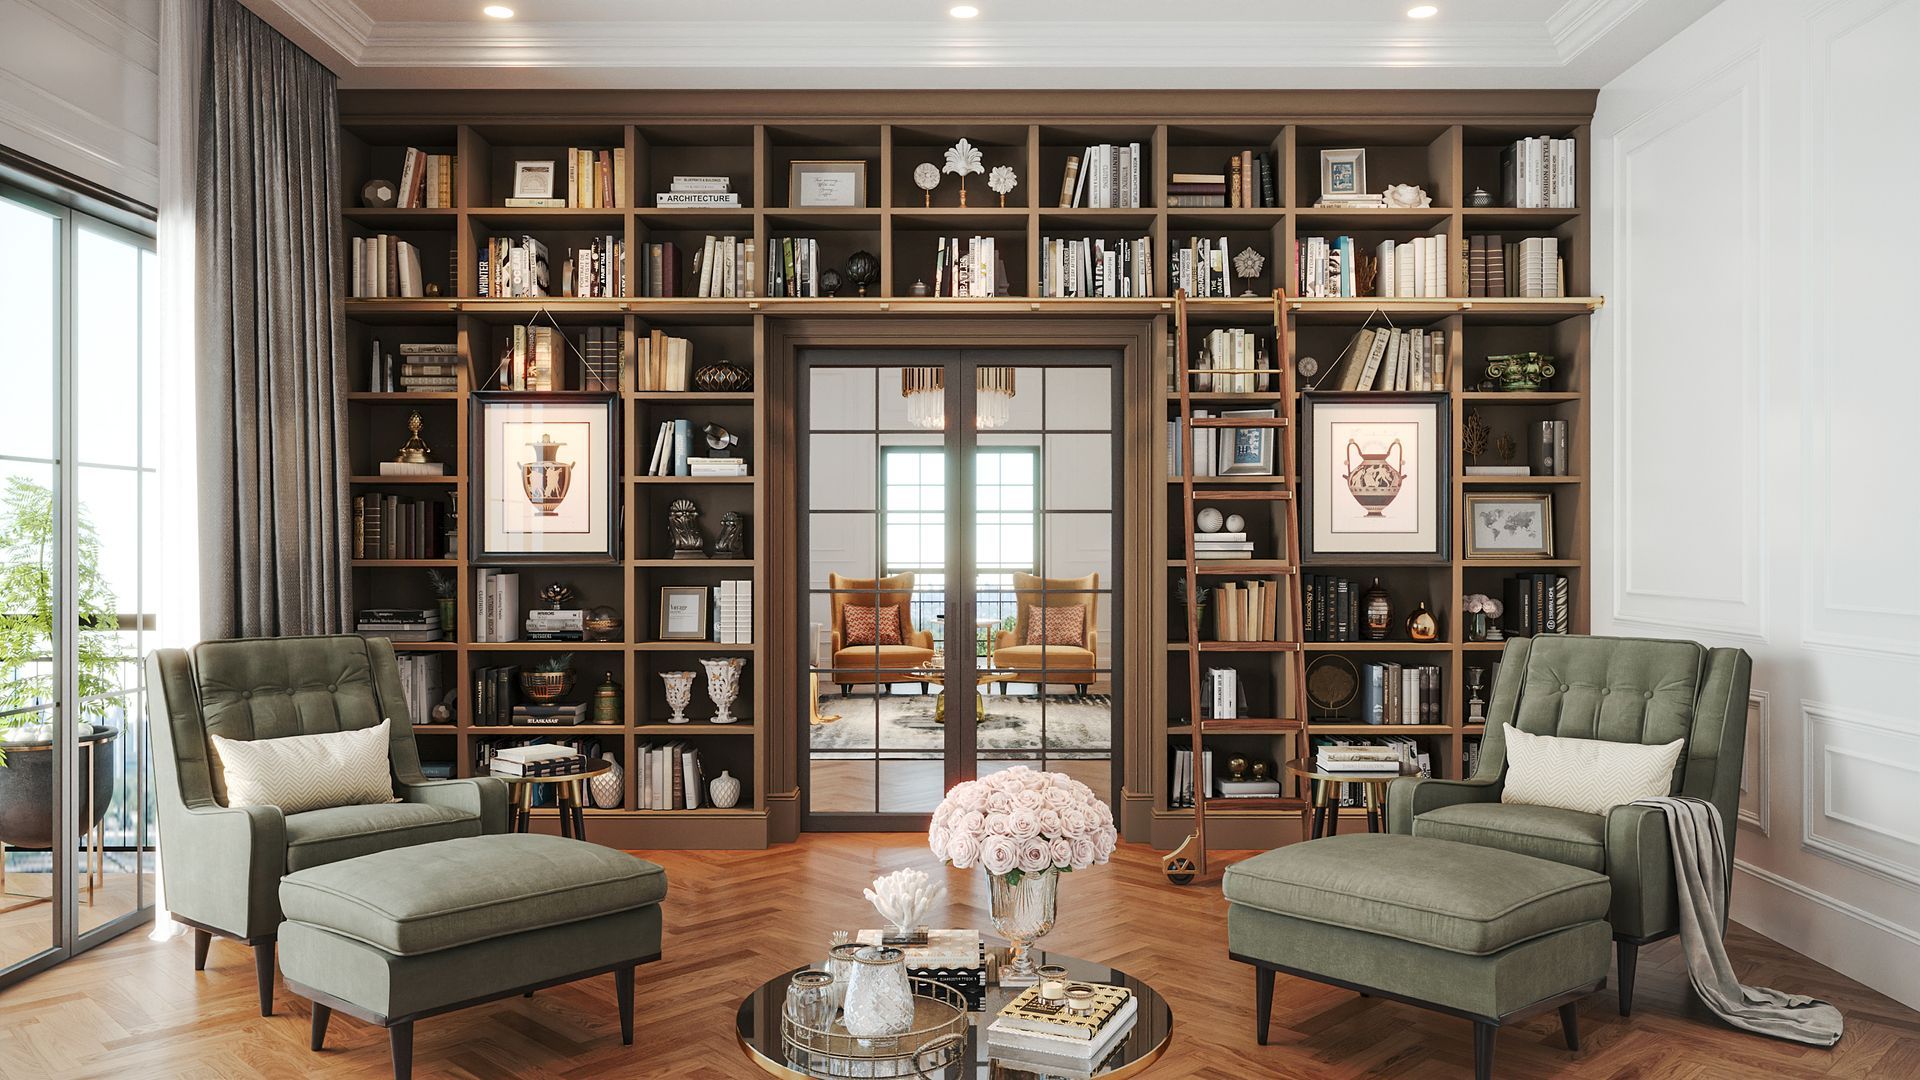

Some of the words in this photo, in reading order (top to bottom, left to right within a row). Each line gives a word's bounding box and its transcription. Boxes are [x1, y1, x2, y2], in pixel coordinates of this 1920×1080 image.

[667, 194, 731, 202] ARCHITECTURE
[512, 250, 522, 285] OCEAN
[959, 257, 968, 297] BEATLES
[1106, 256, 1114, 282] Helvetica
[1304, 591, 1314, 631] Houseology
